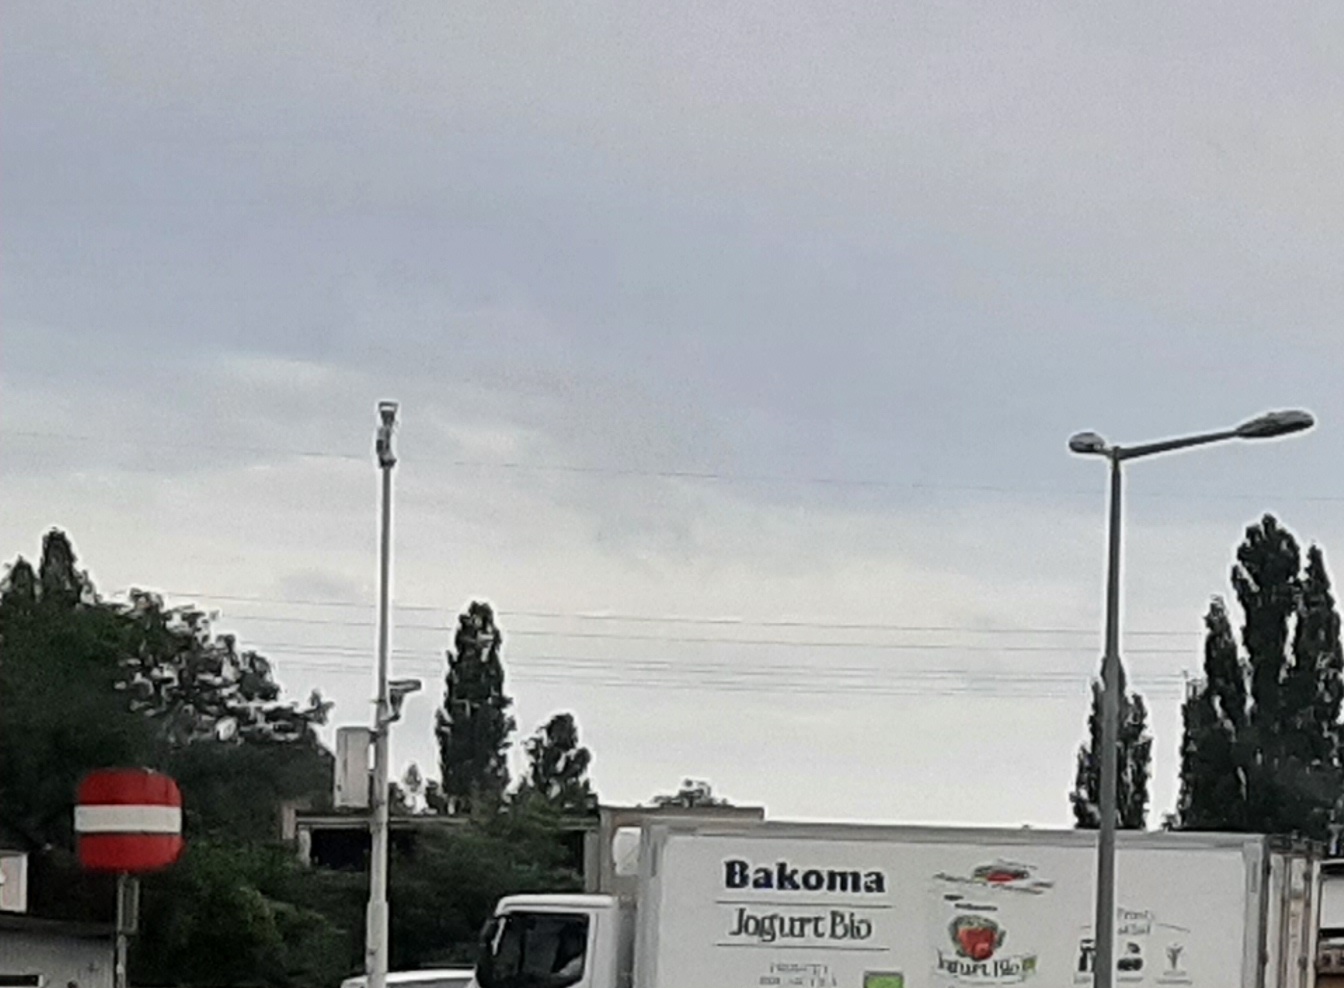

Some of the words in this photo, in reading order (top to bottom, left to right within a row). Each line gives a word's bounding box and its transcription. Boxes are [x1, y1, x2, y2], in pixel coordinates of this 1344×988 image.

[724, 859, 886, 893] Bakoma
[728, 907, 826, 942] Jogurt
[828, 910, 873, 941] Bio
